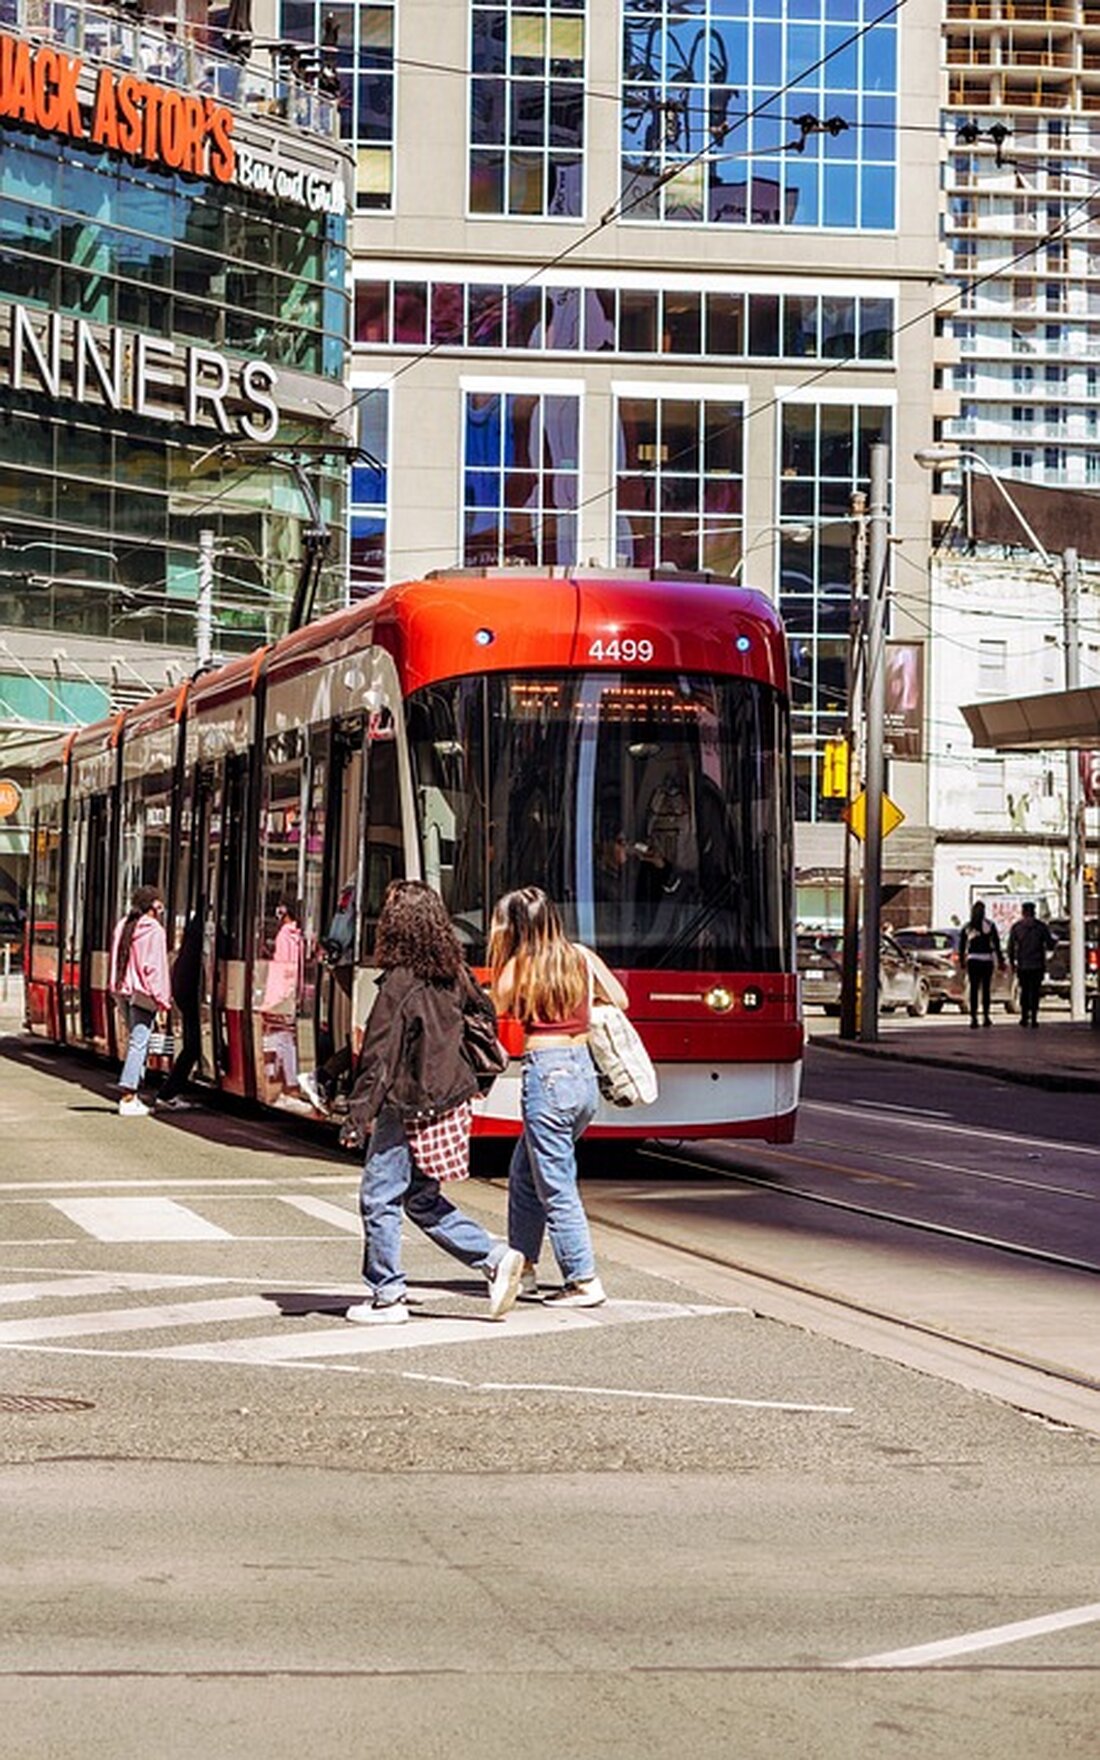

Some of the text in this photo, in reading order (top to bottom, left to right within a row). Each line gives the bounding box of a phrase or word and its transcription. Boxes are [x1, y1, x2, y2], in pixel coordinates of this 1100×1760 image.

[0, 33, 235, 184] JACK ASTOR'S
[237, 149, 278, 197] Bar
[276, 167, 307, 207] and
[12, 304, 280, 443] NNERS
[588, 639, 654, 661] 4499
